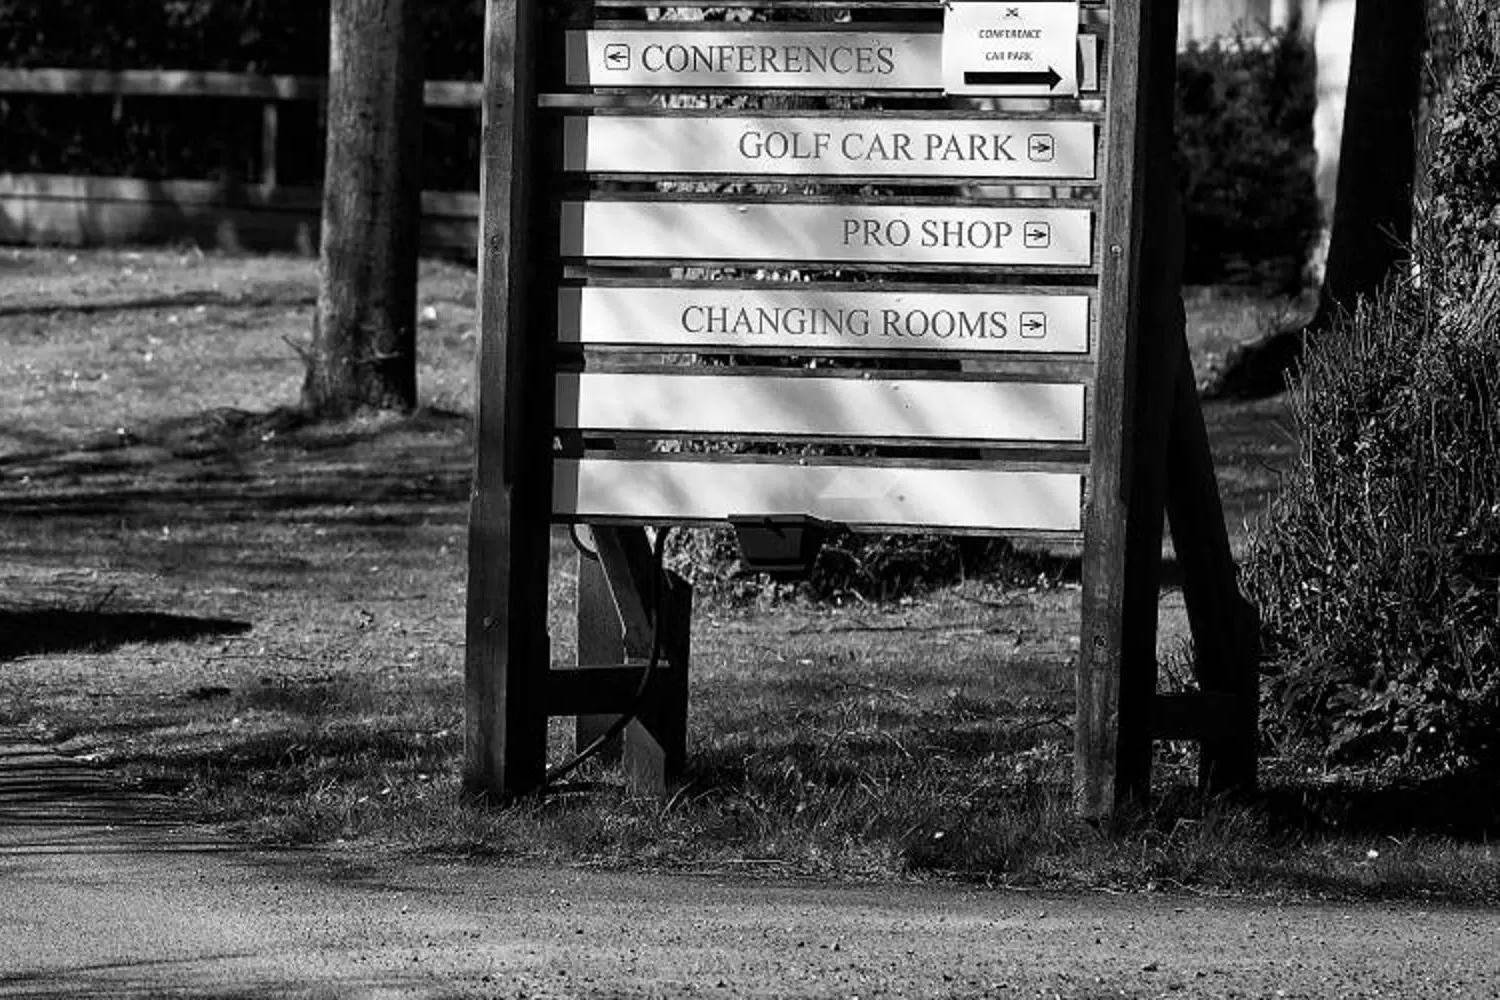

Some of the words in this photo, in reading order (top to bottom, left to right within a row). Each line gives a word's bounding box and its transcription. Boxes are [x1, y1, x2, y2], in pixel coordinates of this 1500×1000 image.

[979, 29, 1042, 39] CONFERENCE
[640, 43, 895, 75] CONFERENCES
[985, 51, 1005, 61] CAR
[1007, 51, 1033, 61] PARK
[738, 130, 831, 161] GOLF
[841, 132, 915, 161] CAR
[925, 134, 1017, 162] PARK
[842, 218, 911, 248] PRO
[920, 219, 1013, 249] SHOP
[681, 305, 871, 337] CHANGING
[879, 309, 1008, 340] ROOMS
